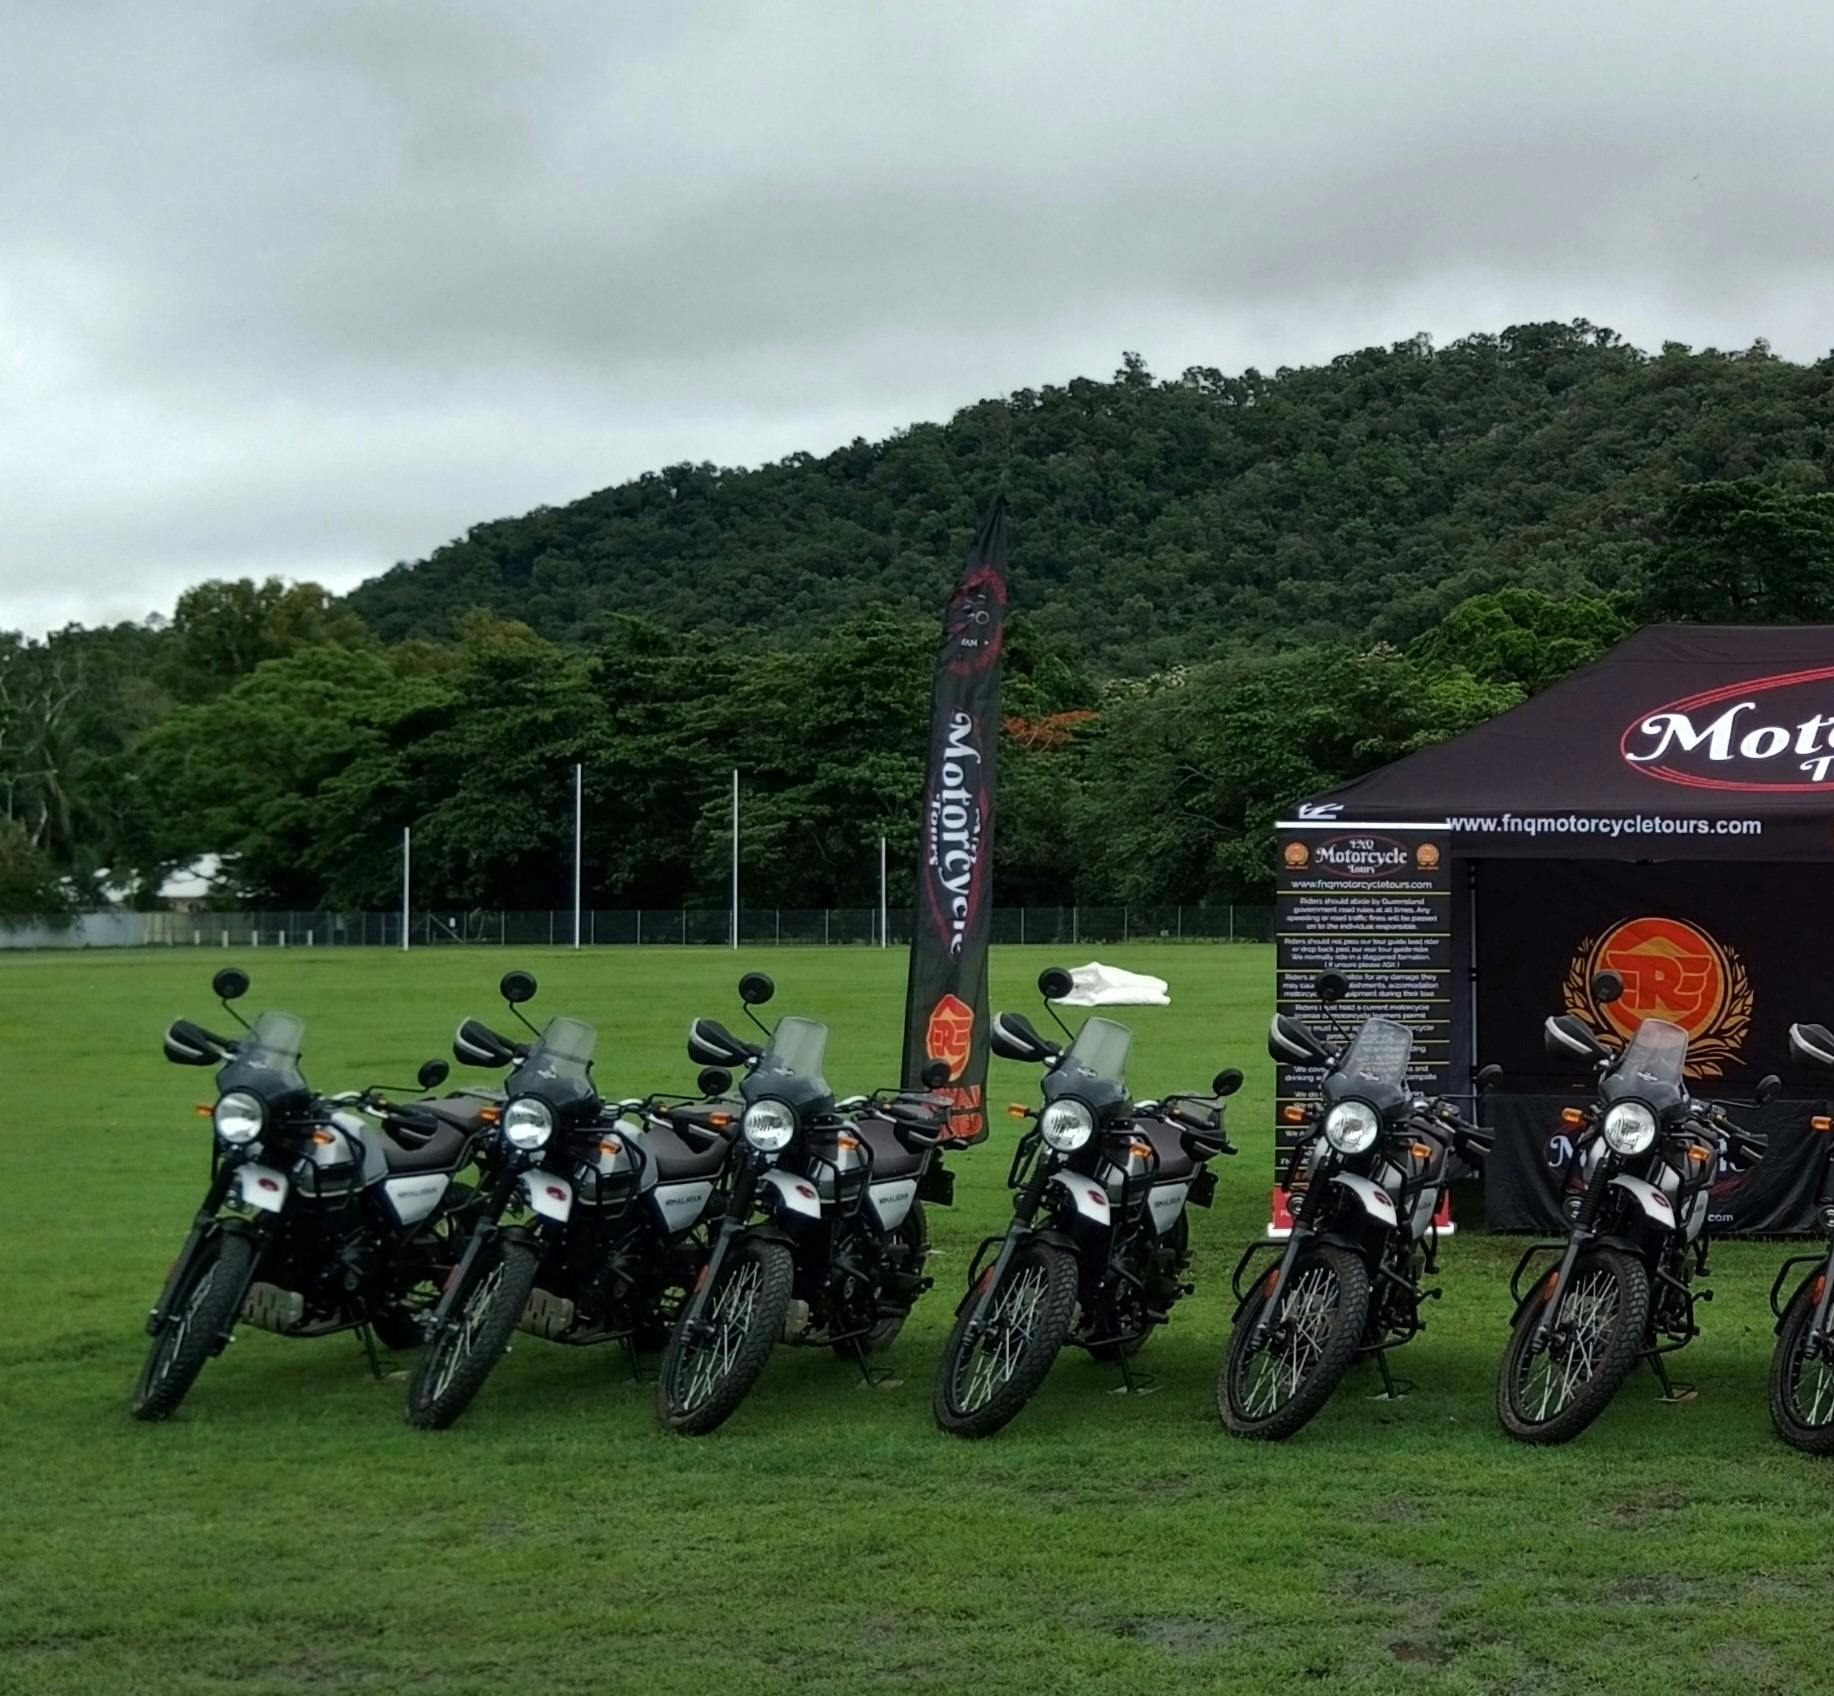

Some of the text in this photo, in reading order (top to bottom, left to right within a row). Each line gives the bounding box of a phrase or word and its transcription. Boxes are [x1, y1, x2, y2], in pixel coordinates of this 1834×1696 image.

[1447, 814, 1761, 837] www.fnqmotorcycletours.com
[1350, 839, 1375, 850] FNQ
[1315, 844, 1407, 867] Motorcycle
[1348, 866, 1375, 874] Tours
[1291, 879, 1432, 889] www.fnqmotorcycletours.com
[1294, 906, 1338, 914] government
[1339, 906, 1355, 914] road
[1417, 906, 1431, 914] Any
[1287, 914, 1320, 922] speeding
[1331, 914, 1346, 922] road
[1348, 914, 1367, 922] traffic
[1388, 914, 1399, 922] will
[1401, 914, 1410, 922] be
[1412, 914, 1437, 922] passed
[1285, 1073, 1318, 1081] drinking
